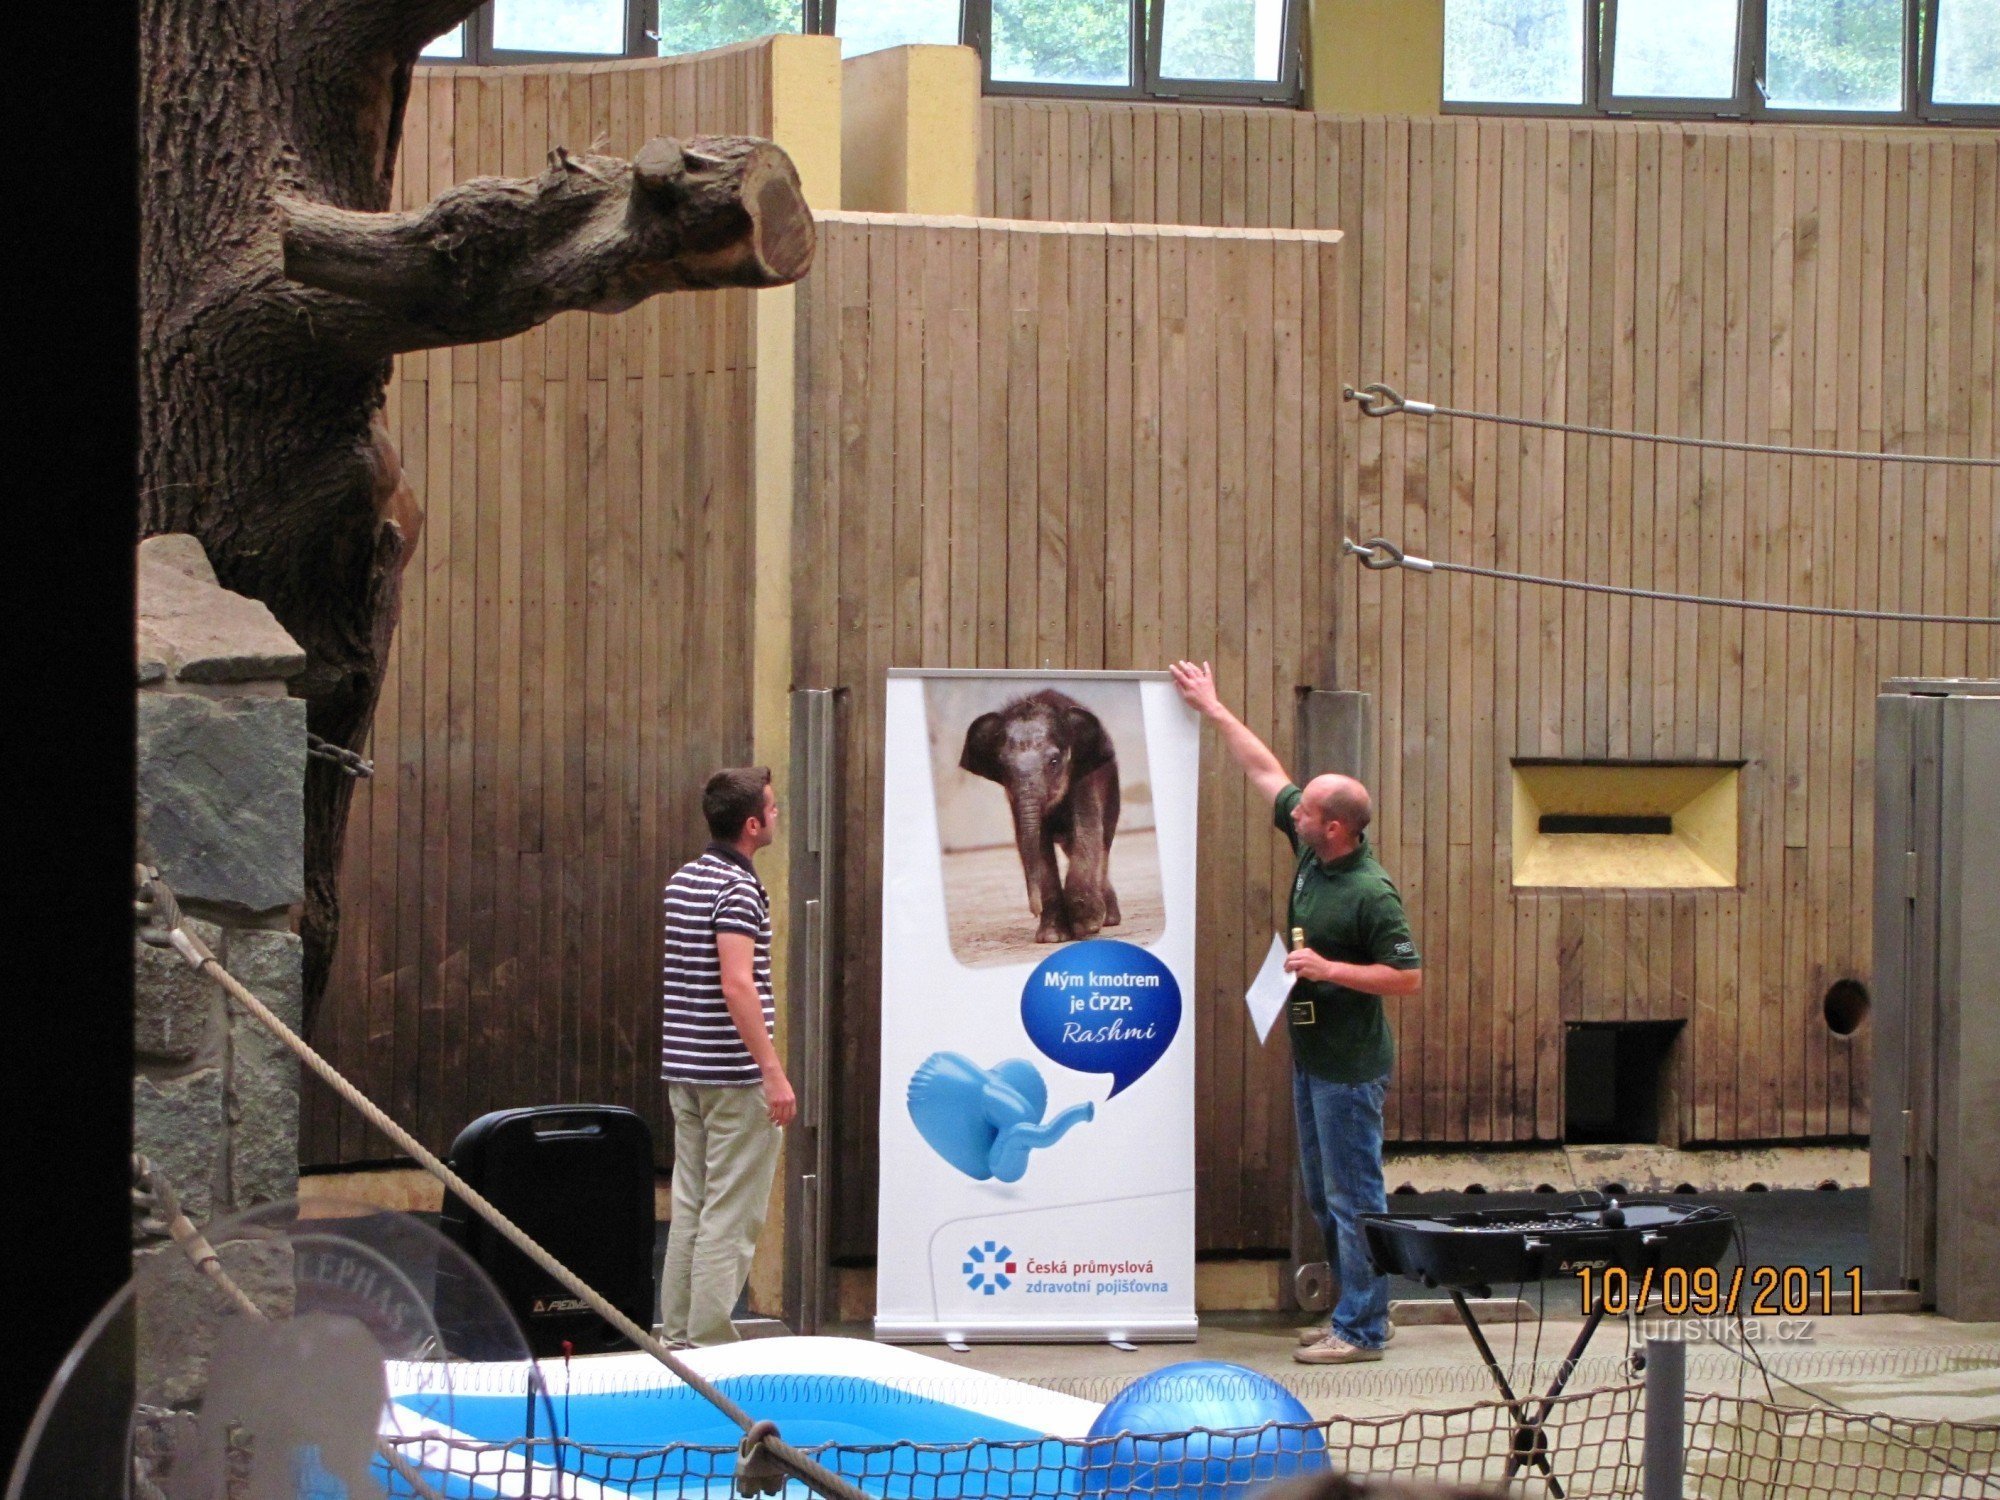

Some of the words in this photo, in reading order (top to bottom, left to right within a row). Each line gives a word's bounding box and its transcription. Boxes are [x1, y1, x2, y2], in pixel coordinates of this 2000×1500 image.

[1044, 971, 1084, 990] Mým
[1089, 971, 1160, 987] kmotrem
[1070, 996, 1085, 1014] je
[1089, 992, 1133, 1011] ČPZP.
[1062, 1018, 1157, 1043] Rashmi
[1026, 1257, 1068, 1275] Česká
[1073, 1260, 1154, 1277] průmyslová
[1026, 1280, 1091, 1293] zdravotní
[1096, 1278, 1168, 1296] pojišťovna
